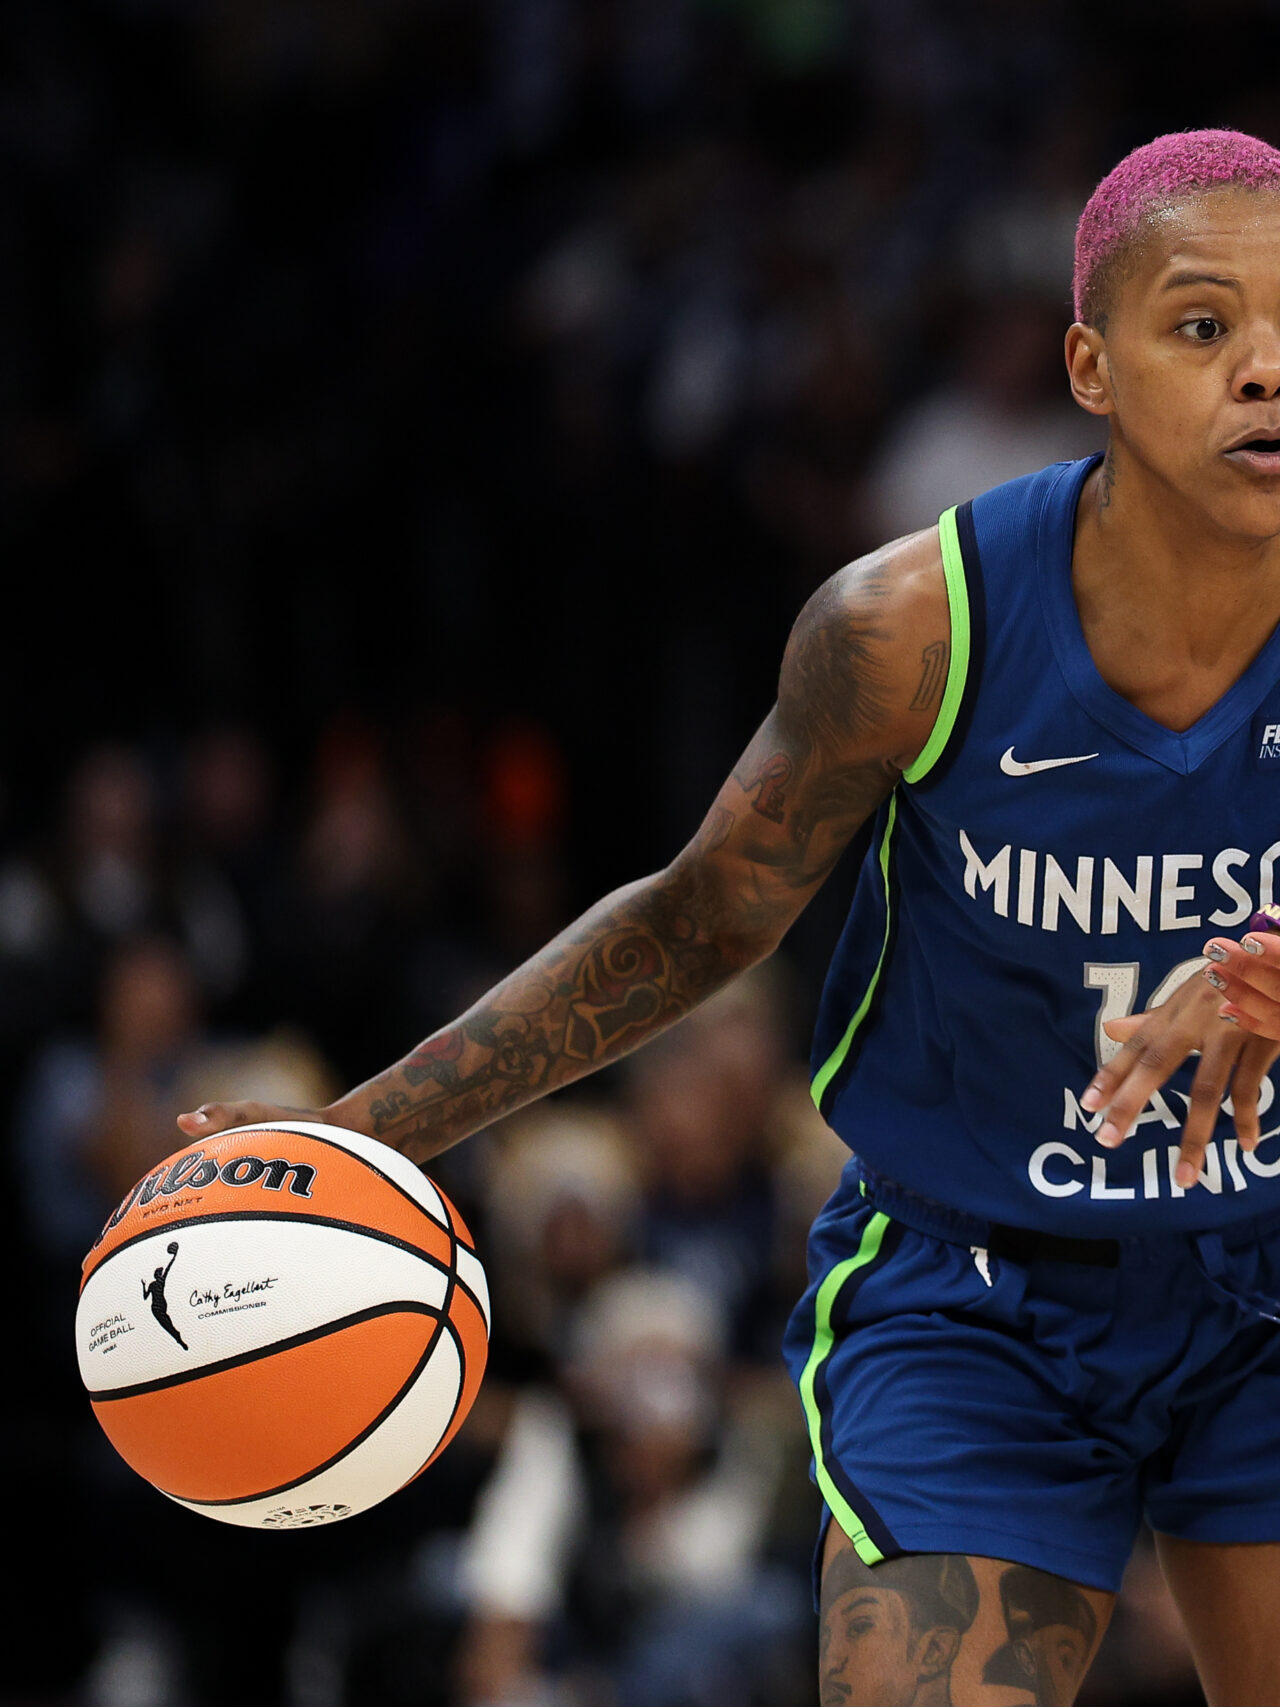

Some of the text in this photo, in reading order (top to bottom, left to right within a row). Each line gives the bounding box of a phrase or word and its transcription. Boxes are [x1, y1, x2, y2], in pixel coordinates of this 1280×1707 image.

[189, 1289, 221, 1308] Cathy
[197, 1301, 267, 1320] COMMISSIONER
[90, 1313, 127, 1338] OFFICIAL
[88, 1323, 136, 1353] GAME BALL
